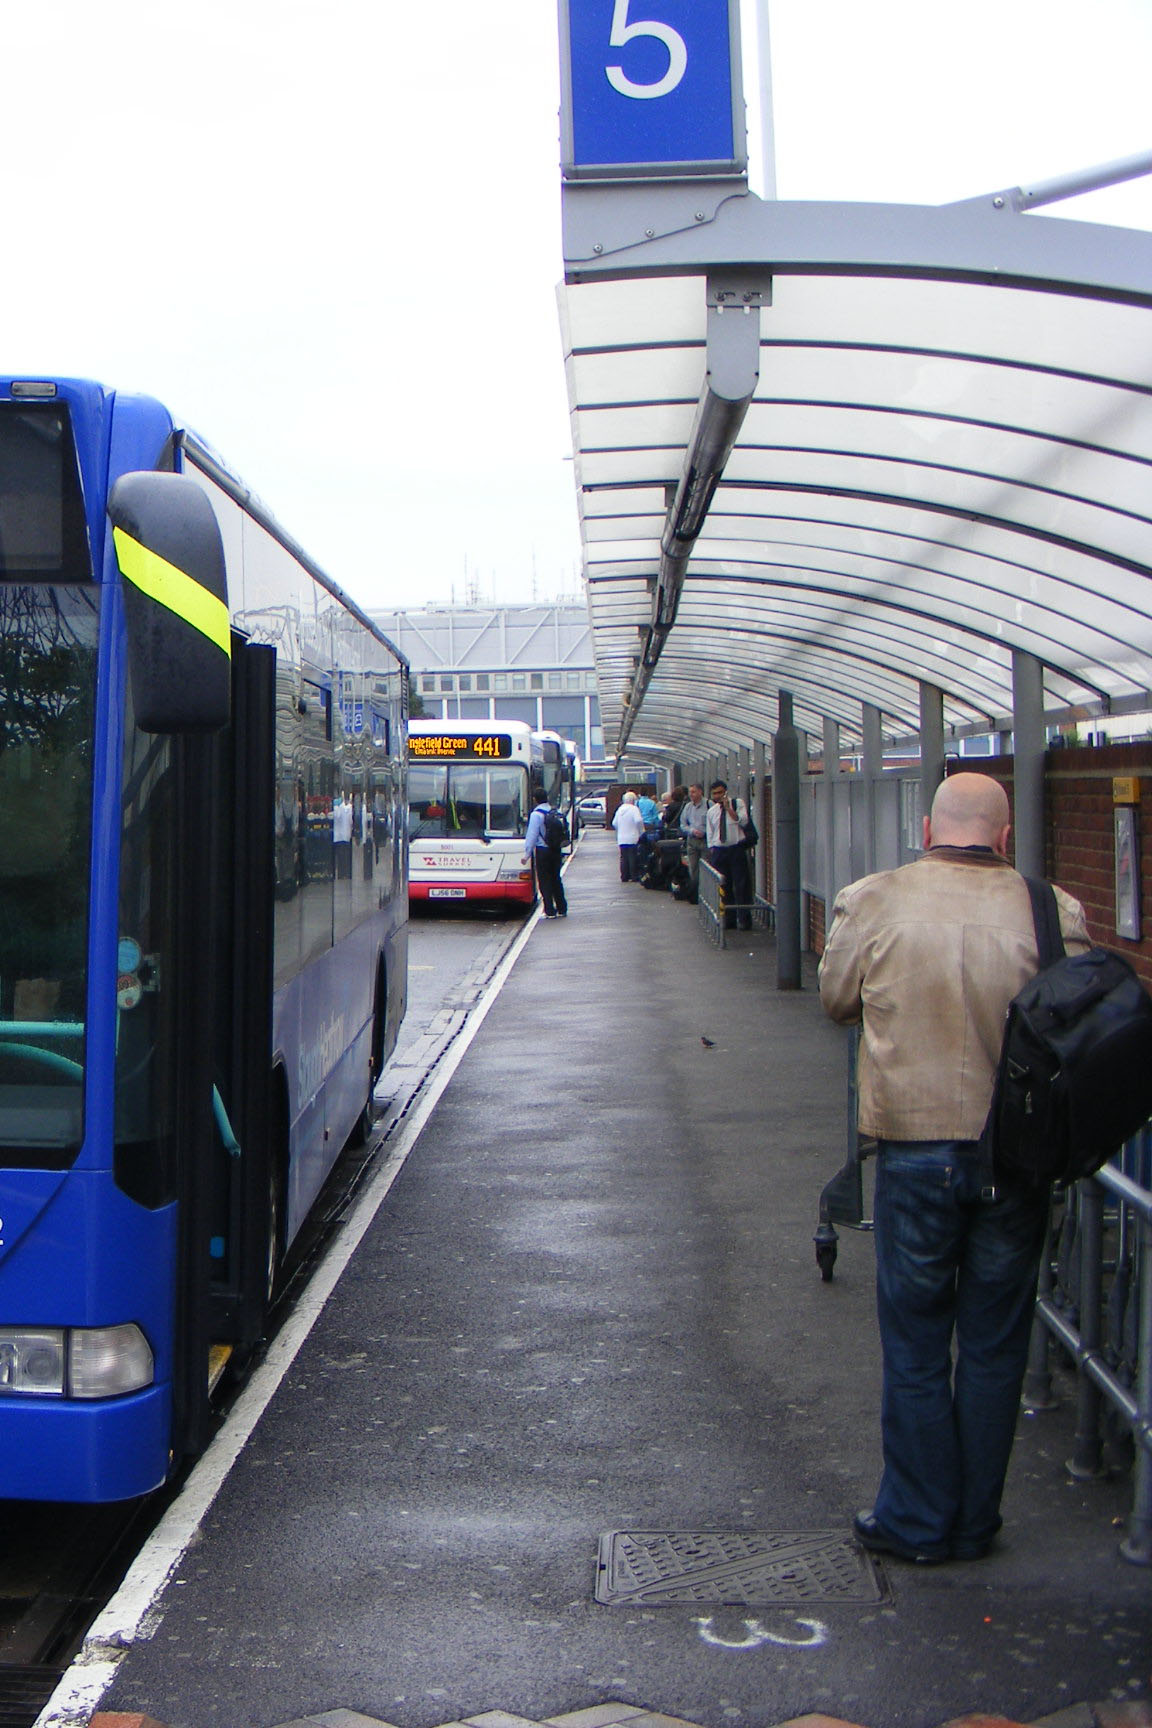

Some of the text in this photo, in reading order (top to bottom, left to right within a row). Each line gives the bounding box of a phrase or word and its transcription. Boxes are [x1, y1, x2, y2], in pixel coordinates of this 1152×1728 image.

[605, 0, 688, 99] 5
[409, 737, 467, 750] nglefield Green
[473, 737, 500, 756] 441
